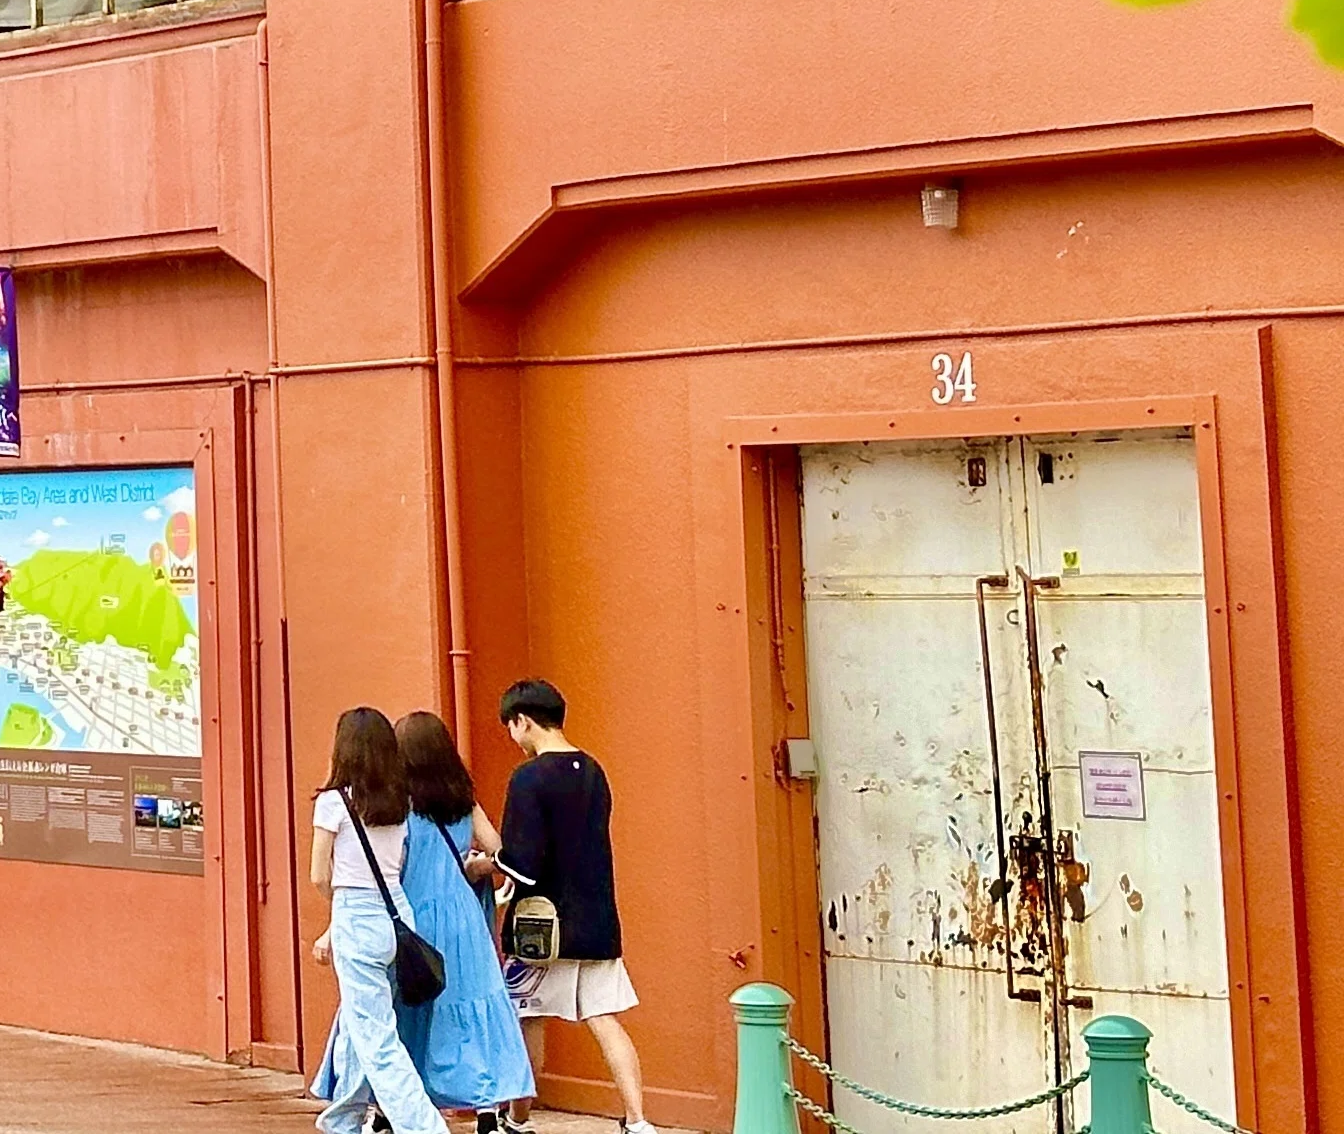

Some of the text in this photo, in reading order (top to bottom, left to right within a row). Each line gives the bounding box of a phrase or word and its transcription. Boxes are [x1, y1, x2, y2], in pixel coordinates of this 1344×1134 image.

[931, 351, 977, 405] 34
[21, 485, 41, 508] Bay
[68, 485, 89, 504] and
